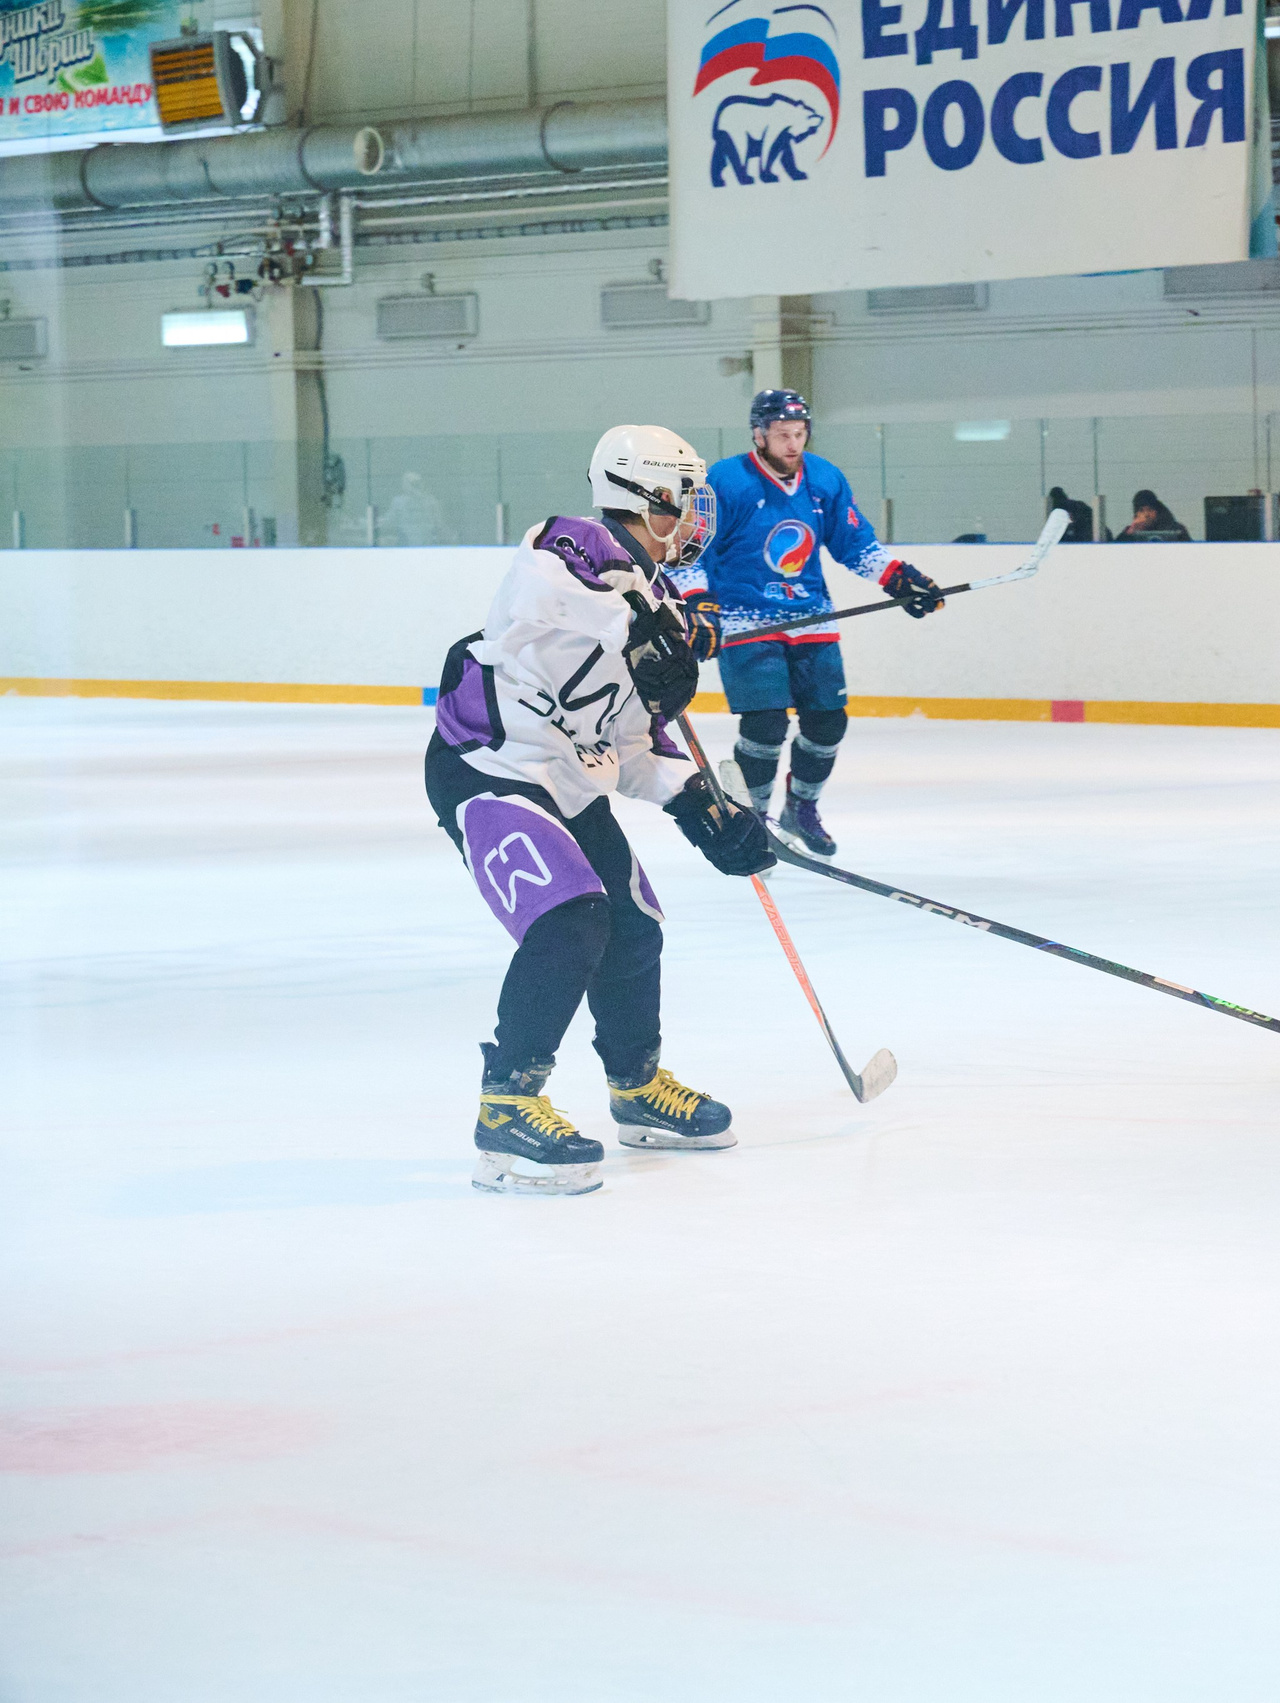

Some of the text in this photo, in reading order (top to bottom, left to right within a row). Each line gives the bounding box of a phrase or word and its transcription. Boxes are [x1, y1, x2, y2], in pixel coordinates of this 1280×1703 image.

[862, 0, 1243, 65] ЕДИ
[9, 97, 20, 115] И
[24, 91, 69, 114] СВОЮ
[73, 83, 152, 108] КОМАНДУ
[863, 47, 1246, 178] РОССИЯ
[888, 891, 992, 932] CCM
